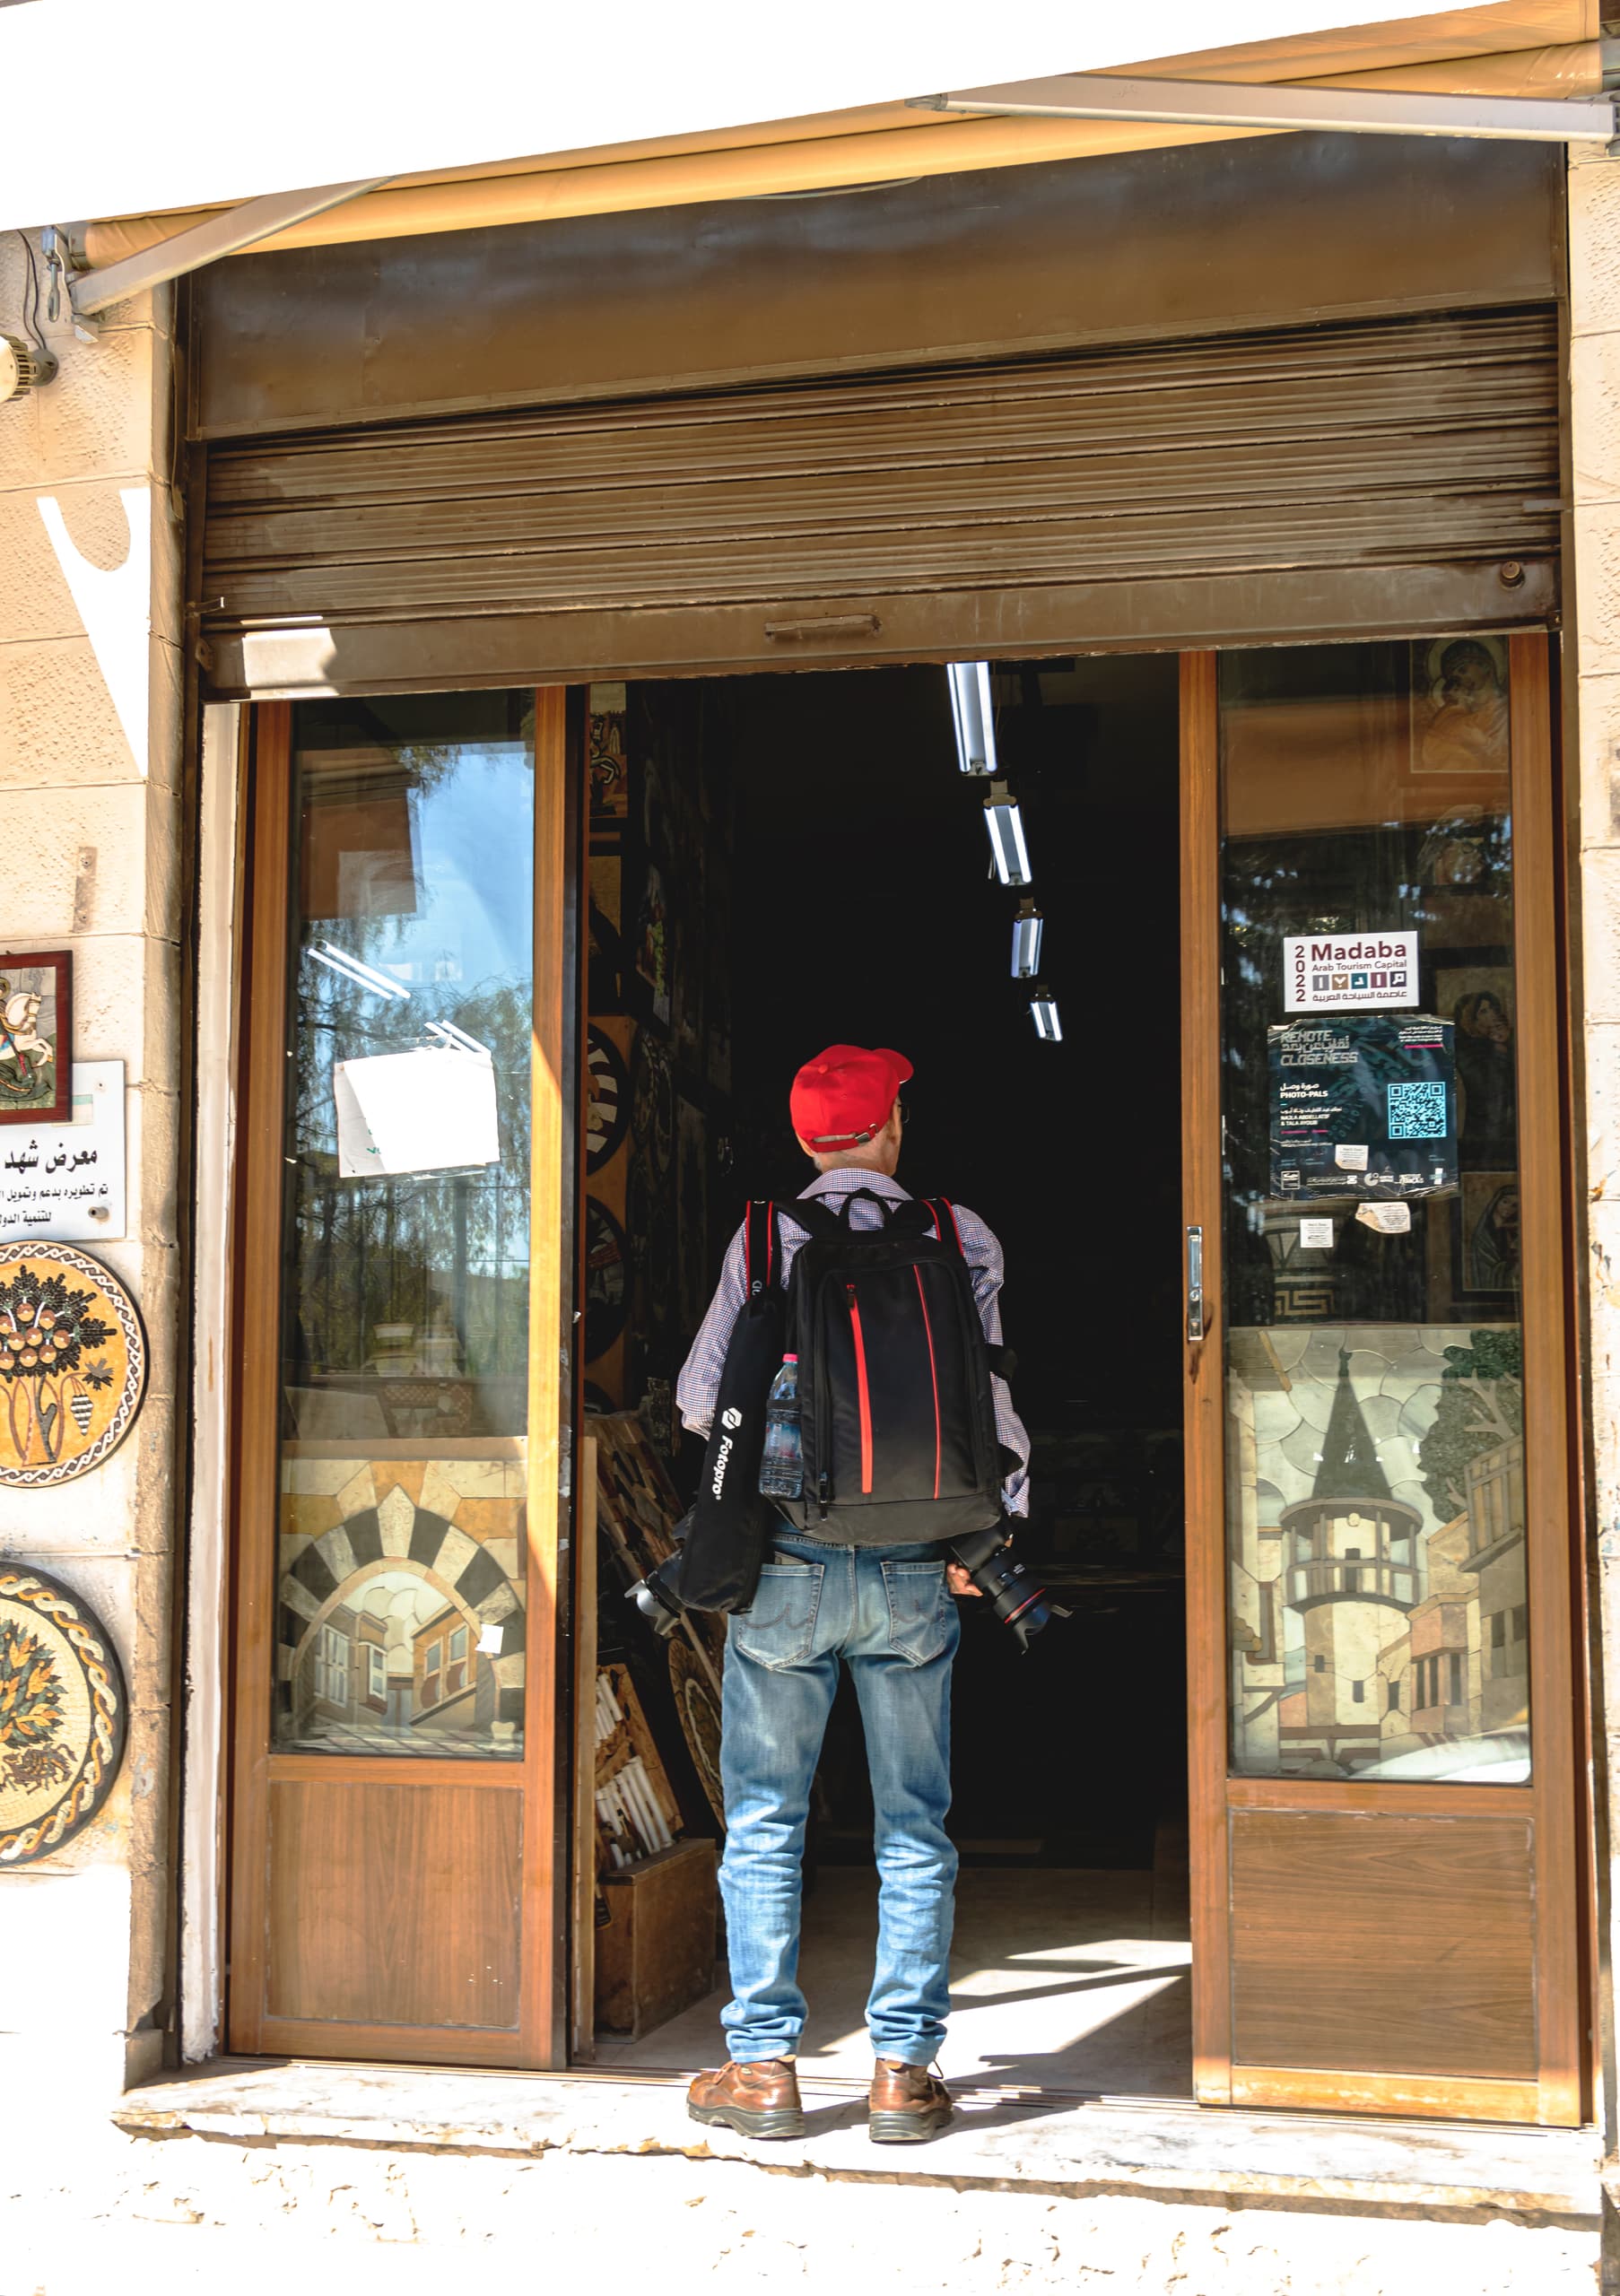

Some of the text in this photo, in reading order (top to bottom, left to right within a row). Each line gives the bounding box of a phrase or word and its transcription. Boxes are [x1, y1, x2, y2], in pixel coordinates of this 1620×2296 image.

[1311, 940, 1407, 961] Madaba
[1311, 960, 1407, 972] Arab Tourism Capital
[1294, 945, 1306, 1003] 2022
[1312, 990, 1407, 1003] عاصمة السياحة العربية
[1281, 1030, 1334, 1043] REMOTE
[1280, 1052, 1360, 1066] CLOSENESS
[1279, 1091, 1328, 1099] PHOTO-PALS
[45, 1142, 98, 1174] معرض
[6, 1186, 37, 1203] وتمويل
[39, 1187, 61, 1201] بدعم
[64, 1183, 96, 1200] تطويره
[98, 1183, 109, 1197] تم
[22, 1210, 52, 1226] للتنمية
[711, 1434, 734, 1495] Fotopro
